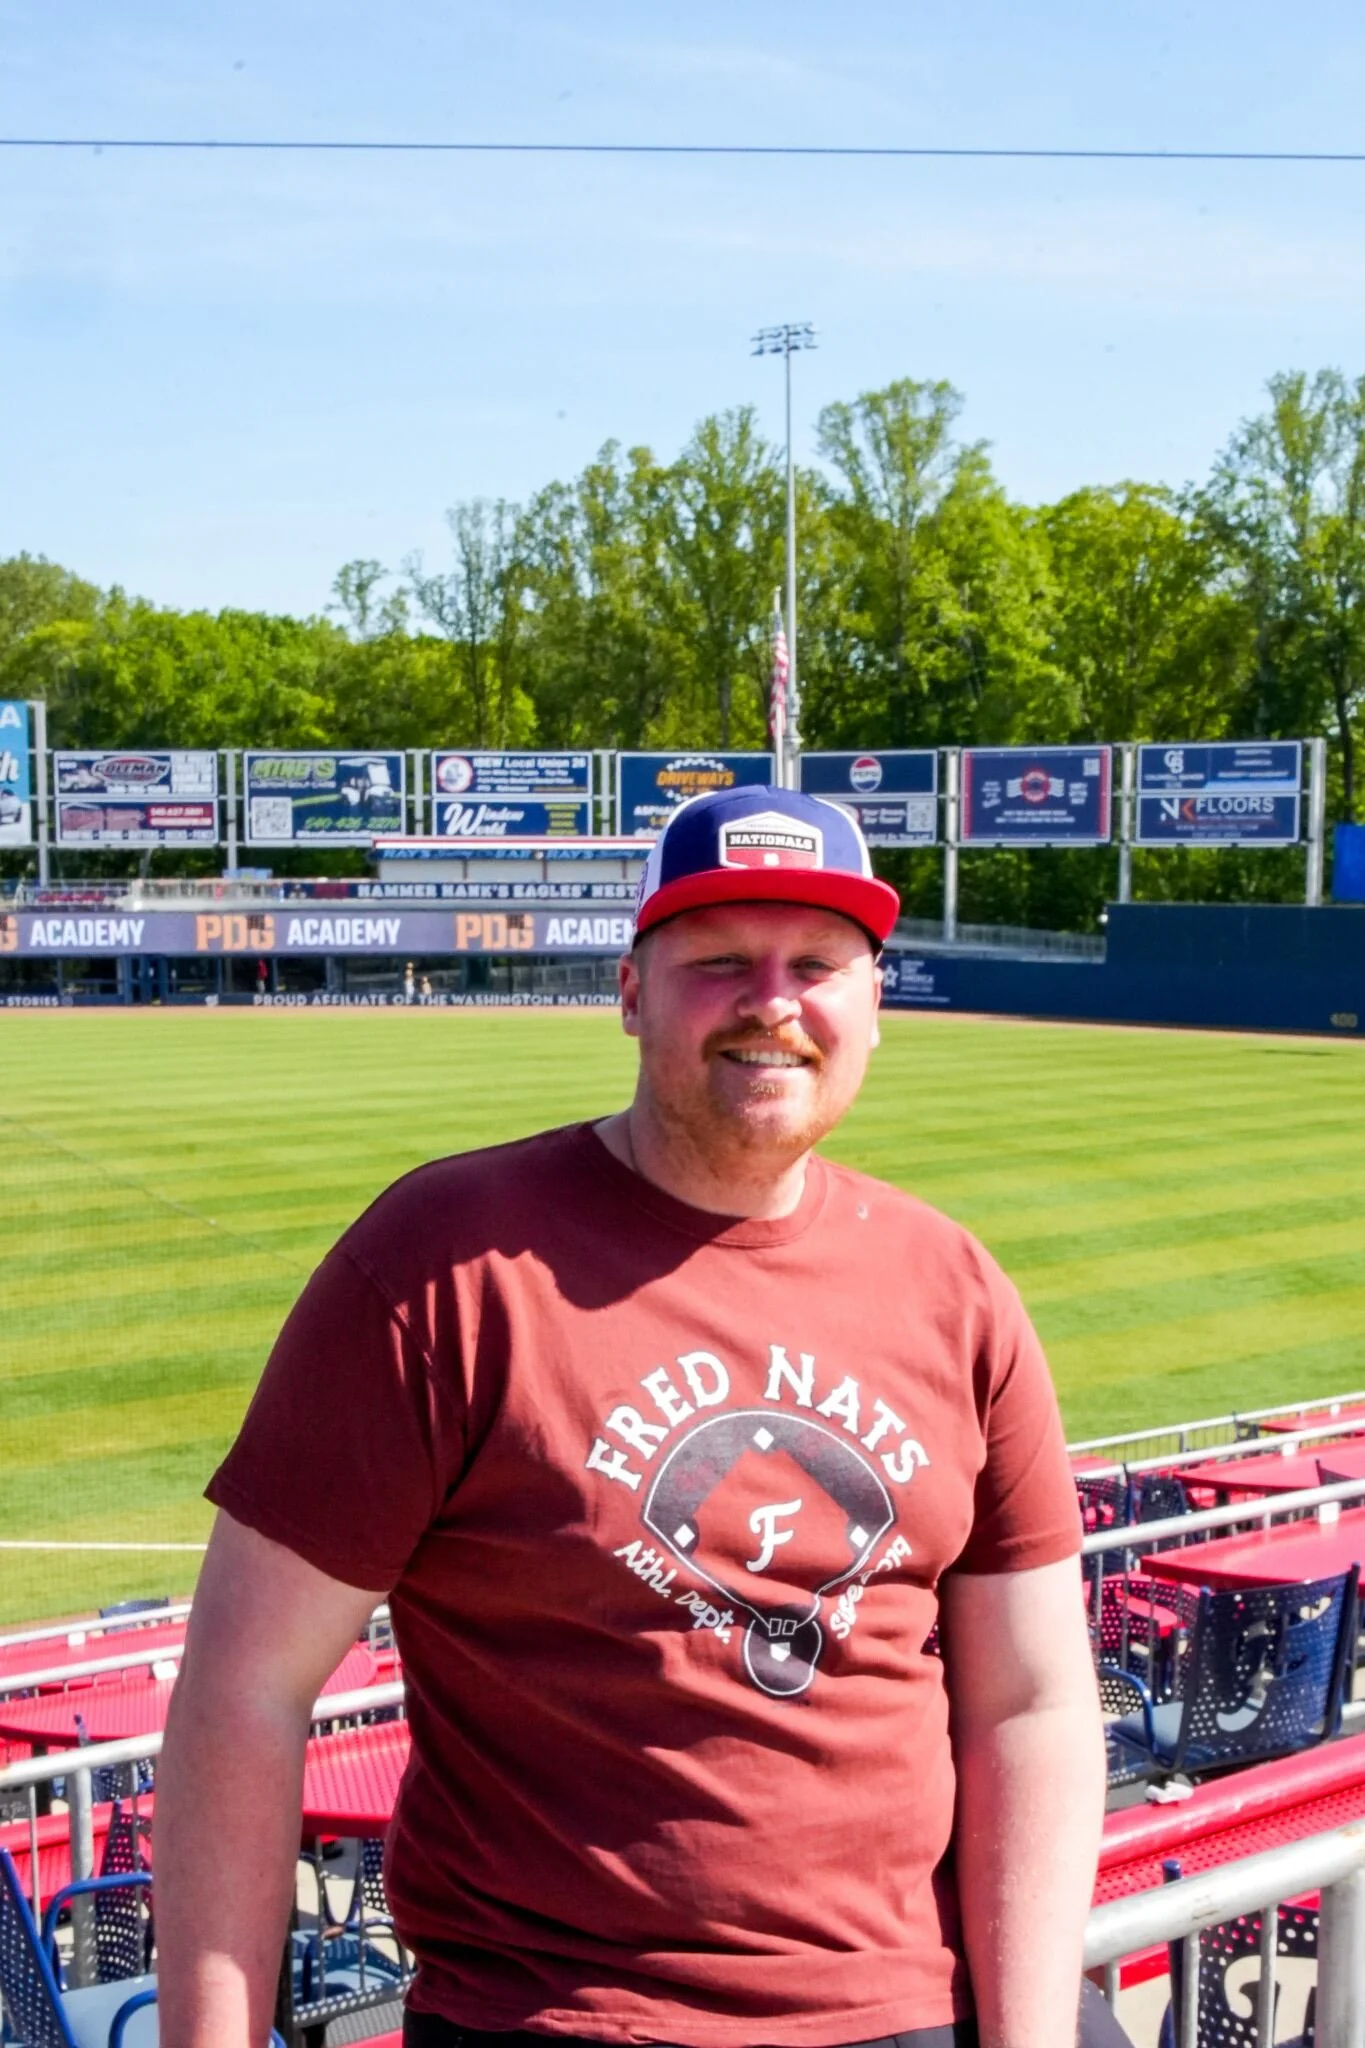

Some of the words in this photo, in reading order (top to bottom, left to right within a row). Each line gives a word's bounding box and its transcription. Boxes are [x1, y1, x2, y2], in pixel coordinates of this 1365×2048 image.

[94, 760, 169, 774] COLEMAN
[504, 757, 535, 768] Local
[537, 758, 569, 768] Union
[656, 771, 735, 786] DRIVEWAYS
[1196, 797, 1275, 813] FLOORS
[729, 834, 813, 850] NATIONALS
[357, 884, 437, 898] HAMMER
[441, 884, 509, 898] HANK'S
[513, 885, 587, 898] EAGLES'
[591, 885, 637, 898] NEST
[30, 918, 145, 947] ACADEMY
[195, 914, 275, 951] PDG
[287, 918, 401, 946] ACADEMY
[456, 912, 535, 950] PDG
[253, 994, 308, 1007] PROUD
[311, 994, 388, 1007] AFFILIATE
[419, 993, 447, 1006] THE
[451, 993, 553, 1006] WASHINGTON
[585, 1351, 731, 1490] FRED
[763, 1344, 931, 1484] NATS
[746, 1498, 802, 1572] F
[613, 1539, 680, 1599] Athl.
[675, 1590, 737, 1645] Dept.
